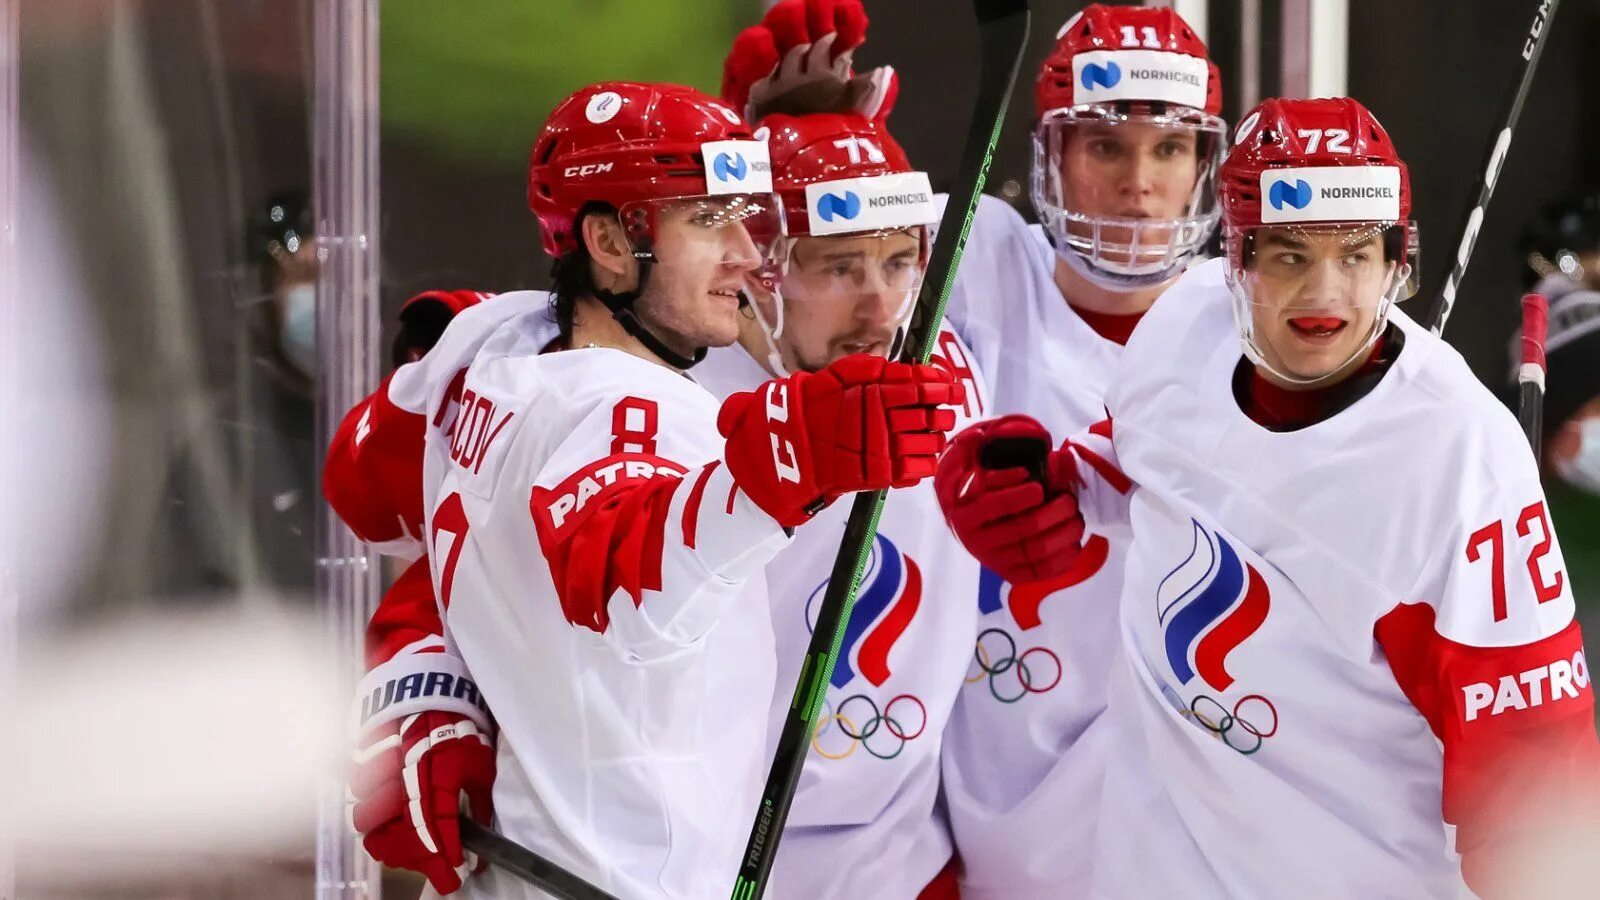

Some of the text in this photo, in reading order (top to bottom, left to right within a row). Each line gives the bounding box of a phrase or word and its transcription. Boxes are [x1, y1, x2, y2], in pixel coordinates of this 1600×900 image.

[1120, 26, 1161, 48] 11
[1130, 69, 1201, 87] NORNICKEL
[832, 136, 887, 165] 71
[1298, 128, 1351, 154] 72
[564, 161, 614, 178] CCM
[868, 192, 930, 208] NORNICKEL
[1321, 186, 1394, 199] NORNICKEL
[610, 395, 659, 456] 8
[1465, 500, 1563, 623] 72
[1461, 646, 1591, 722] PATRO
